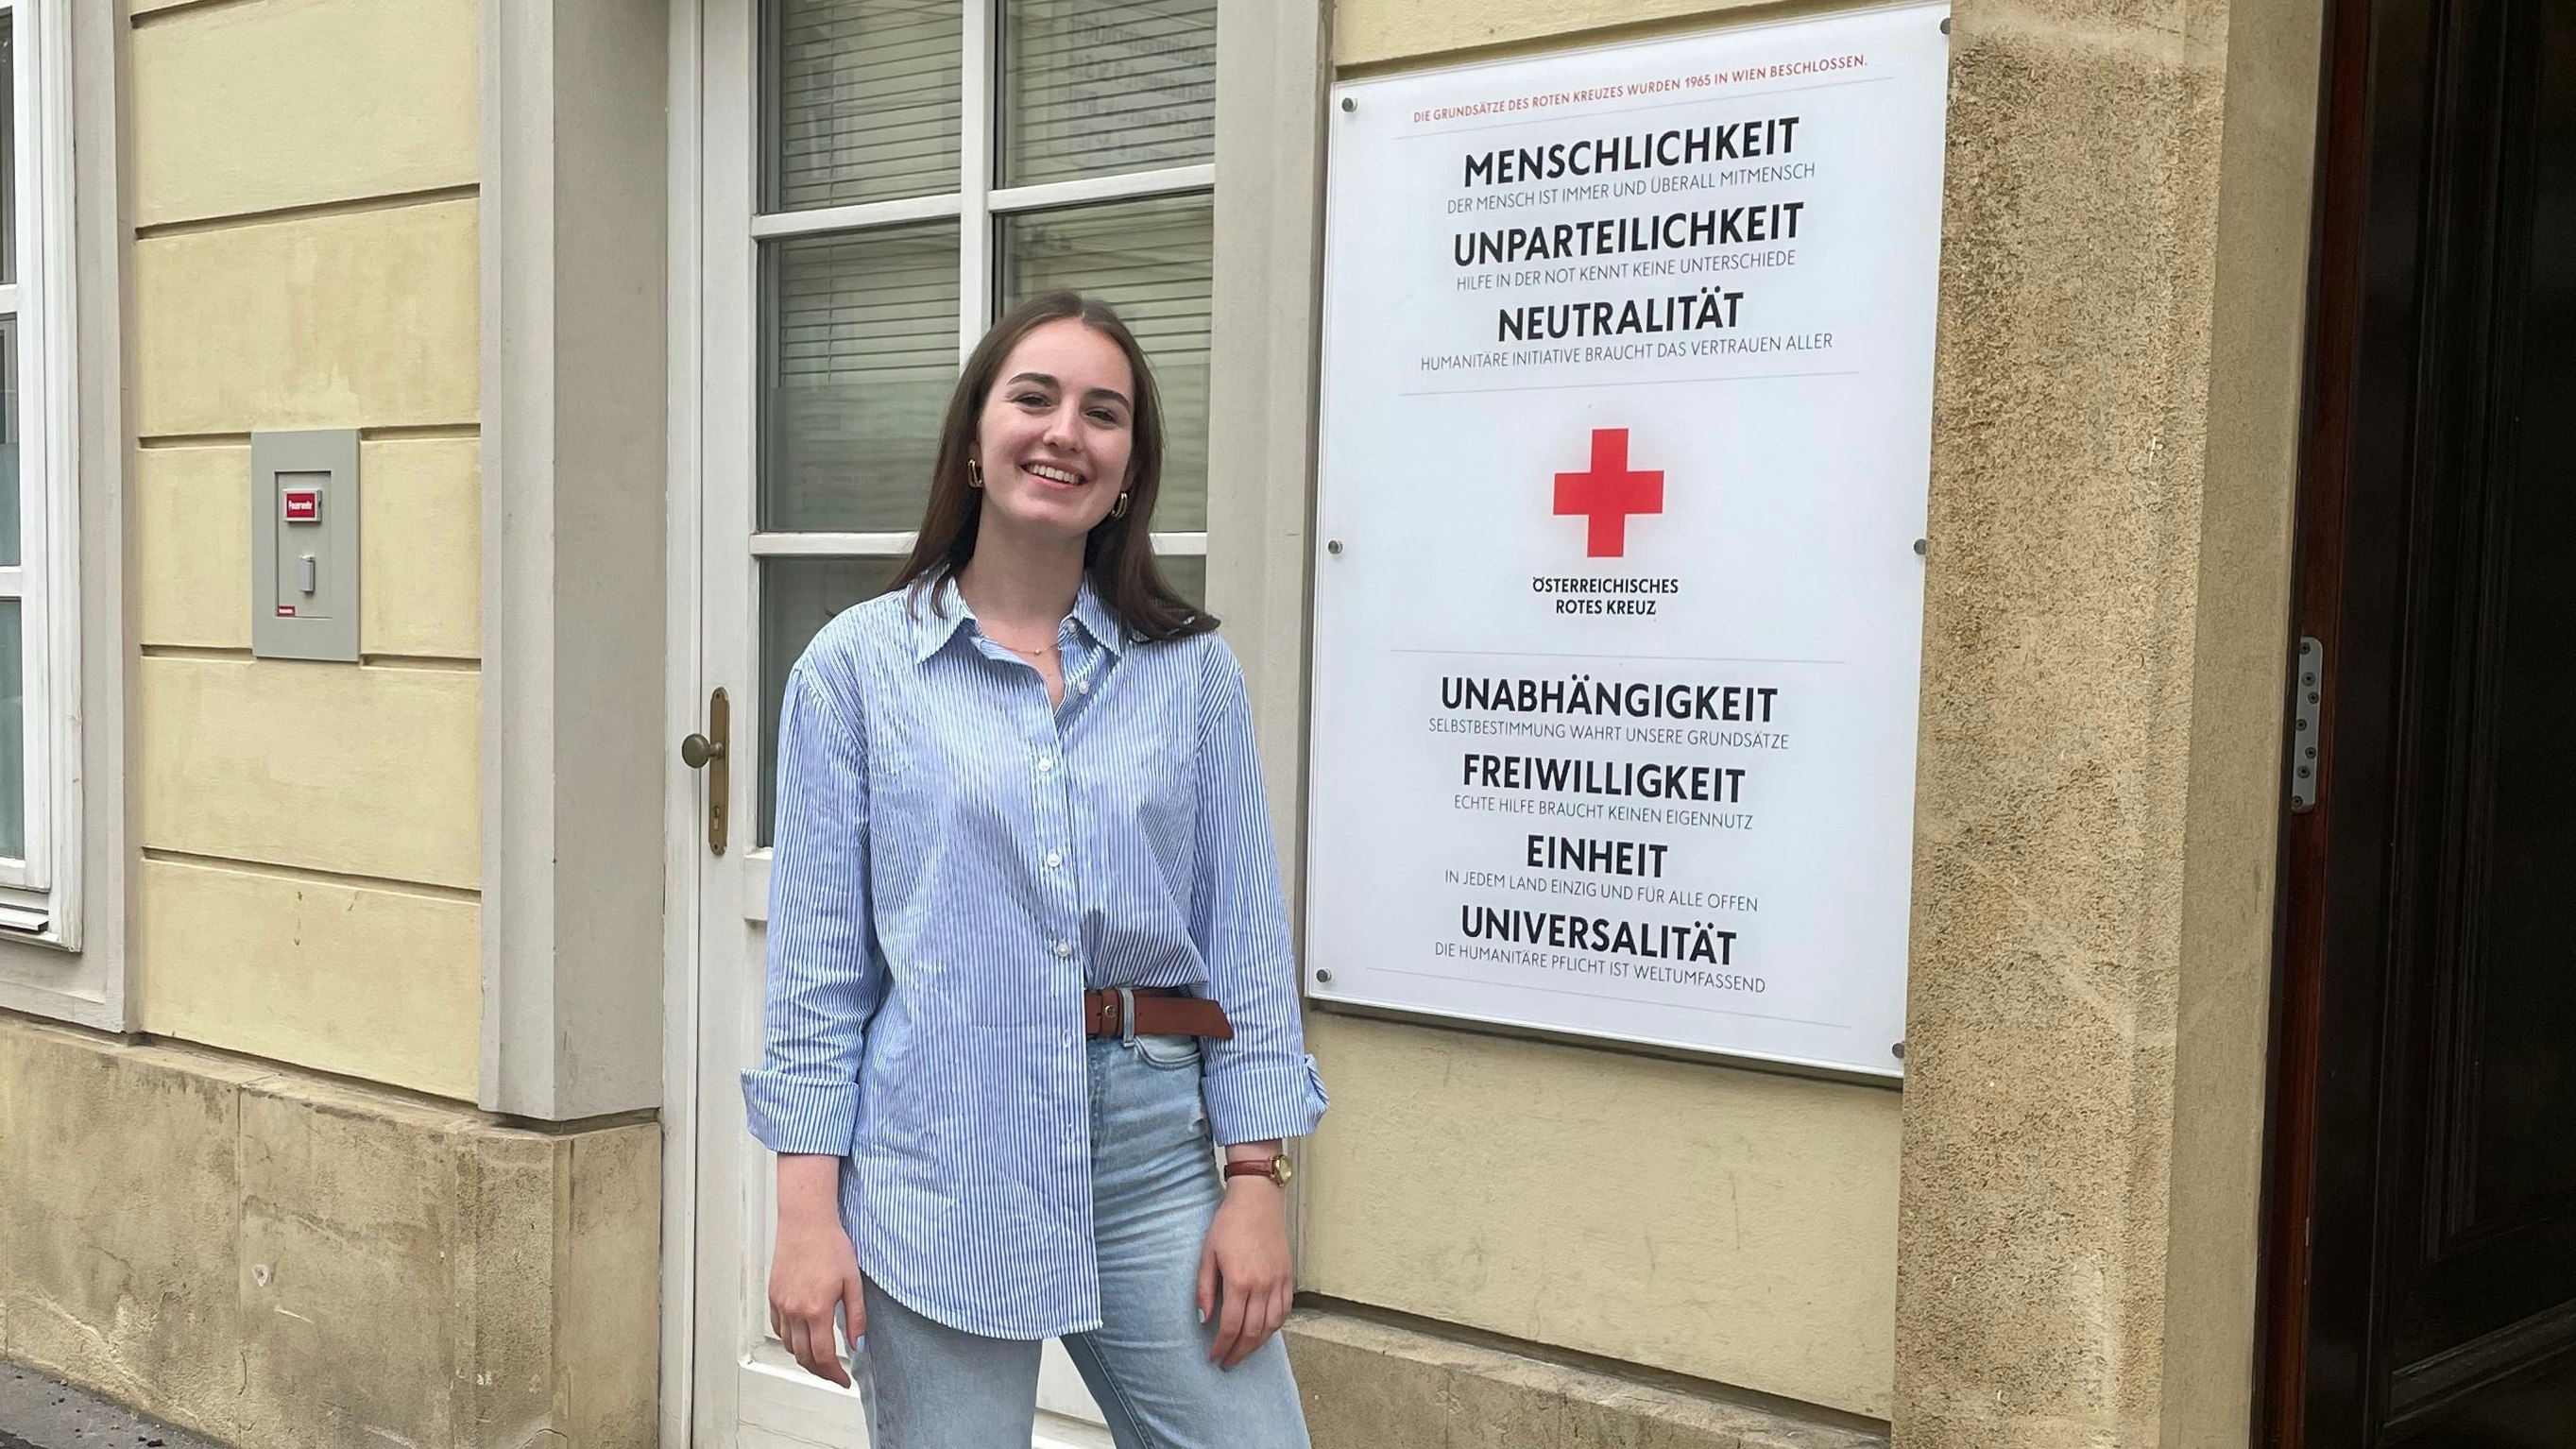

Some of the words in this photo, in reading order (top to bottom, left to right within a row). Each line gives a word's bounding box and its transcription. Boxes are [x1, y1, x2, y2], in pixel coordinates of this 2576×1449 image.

[1414, 111, 1430, 123] DIE
[1434, 101, 1505, 120] GRUNDSÄTZE
[1509, 98, 1528, 111] DES
[1532, 94, 1570, 108] ROTEN
[1574, 86, 1623, 102] KREUZES
[1628, 78, 1680, 95] WURDEN
[1685, 75, 1711, 88] 1965
[1714, 73, 1728, 85] IN
[1732, 67, 1766, 82] WIEN
[1770, 55, 1867, 77] BESCHLOSSEN.
[1464, 116, 1800, 188] MENSCHLICHKEIT
[1448, 198, 1473, 213] DER
[1476, 192, 1534, 211] MENSCH
[1540, 189, 1558, 204] IST
[1562, 184, 1609, 202] IMMER
[1613, 180, 1646, 197] UND
[1651, 173, 1715, 193] ÜBERALL
[1720, 162, 1815, 186] MITMENSCH
[1455, 201, 1804, 266] UNPARTEILICHKEIT
[1458, 275, 1493, 290] HILFE
[1496, 273, 1510, 287] IN
[1515, 271, 1541, 286] DER
[1545, 267, 1576, 283] NOT
[1580, 264, 1629, 281] KENNT
[1633, 260, 1676, 277] KEINE
[1680, 249, 1796, 273] UNTERSCHIEDE
[1498, 285, 1744, 342] NEUTRALITÄT
[1422, 352, 1509, 370] HUMANITÄRE
[1513, 348, 1580, 366] INITIATIVE
[1586, 344, 1653, 362] BRAUCHT
[1658, 342, 1686, 358] DAS
[1691, 336, 1781, 355] VERTRAUEN
[1785, 333, 1832, 350] ALLER
[1533, 576, 1679, 593] ÖSTERREICHISCHES
[1556, 599, 1602, 615] ROTES
[1607, 600, 1656, 615] KREUZ
[1442, 673, 1778, 723] UNABHÄNGIGKEIT
[1429, 718, 1565, 738] SELBSTBESTIMMUNG
[1570, 724, 1622, 741] WAHRT
[1627, 727, 1683, 744] UNSERE
[1688, 730, 1789, 749] GRUNDSÄTZE
[1464, 754, 1746, 803] FREIWILLIGKEIT
[1455, 794, 1494, 810] ECHTE
[1499, 798, 1534, 813] HILFE
[1540, 801, 1604, 818] BRAUCHT
[1609, 806, 1662, 823] KEINEN
[1667, 810, 1752, 829] EIGENNUTZ
[1527, 834, 1668, 878] EINHEIT
[1446, 870, 1459, 883] IN
[1463, 872, 1505, 888] JEDEM
[1510, 876, 1546, 892] LAND
[1552, 879, 1596, 896] EINZIG
[1601, 884, 1632, 900] UND
[1638, 886, 1664, 903] FÜR
[1669, 890, 1702, 907] ALLE
[1708, 894, 1757, 912] OFFEN
[1462, 905, 1736, 965] UNIVERSALITÄT
[1436, 942, 1455, 957] DIE
[1459, 946, 1547, 968] HUMANITÄRE
[1552, 955, 1605, 974] PFLICHT
[1610, 962, 1629, 977] IST
[1634, 964, 1765, 993] WELTUMFASSEND
